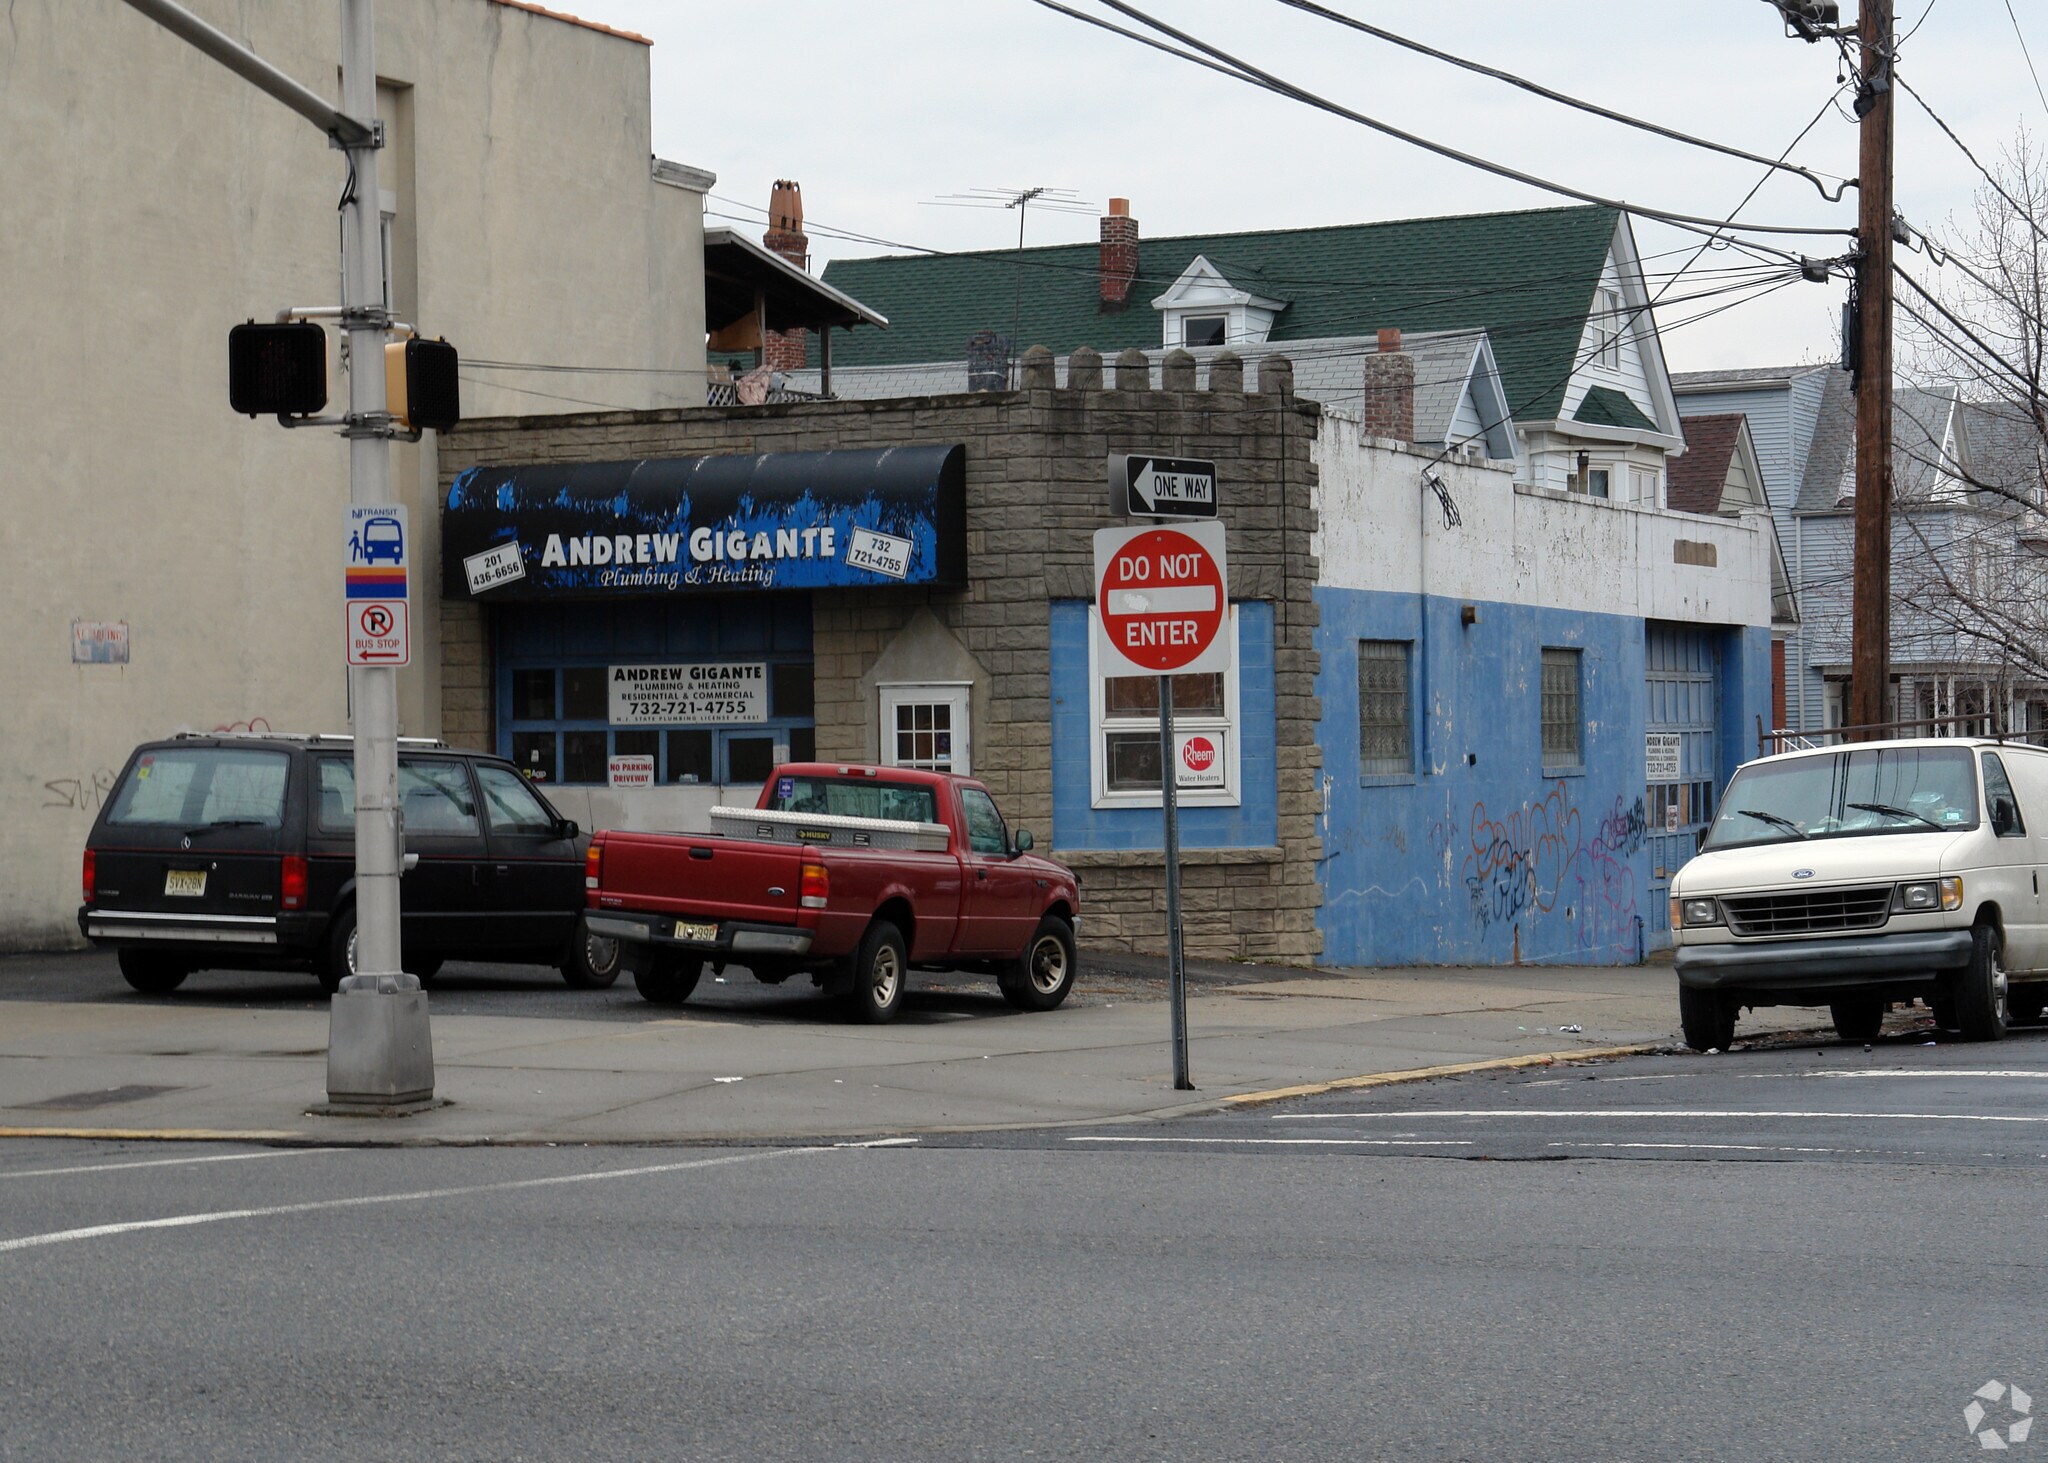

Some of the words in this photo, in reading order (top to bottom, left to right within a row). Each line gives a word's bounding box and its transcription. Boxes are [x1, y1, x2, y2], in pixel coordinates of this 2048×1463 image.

[1154, 475, 1178, 498] ONE
[1185, 477, 1208, 499] WAY
[363, 508, 397, 516] TRANSIT
[541, 533, 679, 567] ANDREW
[690, 527, 835, 562] GIGANTE
[872, 538, 891, 553] 732
[485, 553, 502, 568] 201
[855, 549, 901, 572] 721-4755
[1119, 556, 1150, 581] DO
[1160, 553, 1202, 579] NOT
[473, 562, 519, 586] 436-6656
[601, 567, 678, 590] Plumbing
[684, 565, 702, 584] &
[707, 563, 774, 588] Heating
[1126, 620, 1198, 647] ENTER
[355, 639, 373, 649] BUS
[377, 639, 400, 649] STOP
[614, 668, 682, 681] ANDREW
[689, 666, 762, 680] GIGANTE
[634, 682, 684, 691] PLUMBING
[687, 682, 694, 690] &
[698, 681, 740, 690] HEATING
[621, 692, 679, 701] RESIDENTIAL
[683, 692, 689, 700] &
[693, 690, 754, 700] COMMERCIAL
[630, 701, 746, 715] 732-721-4755
[1646, 736, 1661, 746] NDREW
[1662, 735, 1680, 746] GIGANTE
[1184, 738, 1214, 766] Rheem
[610, 763, 620, 771] NO
[622, 763, 652, 771] PARKING
[613, 774, 649, 783] DRIVEWAY
[1178, 774, 1196, 782] Water
[1197, 774, 1220, 782] Heaters
[806, 831, 830, 839] HUSKY
